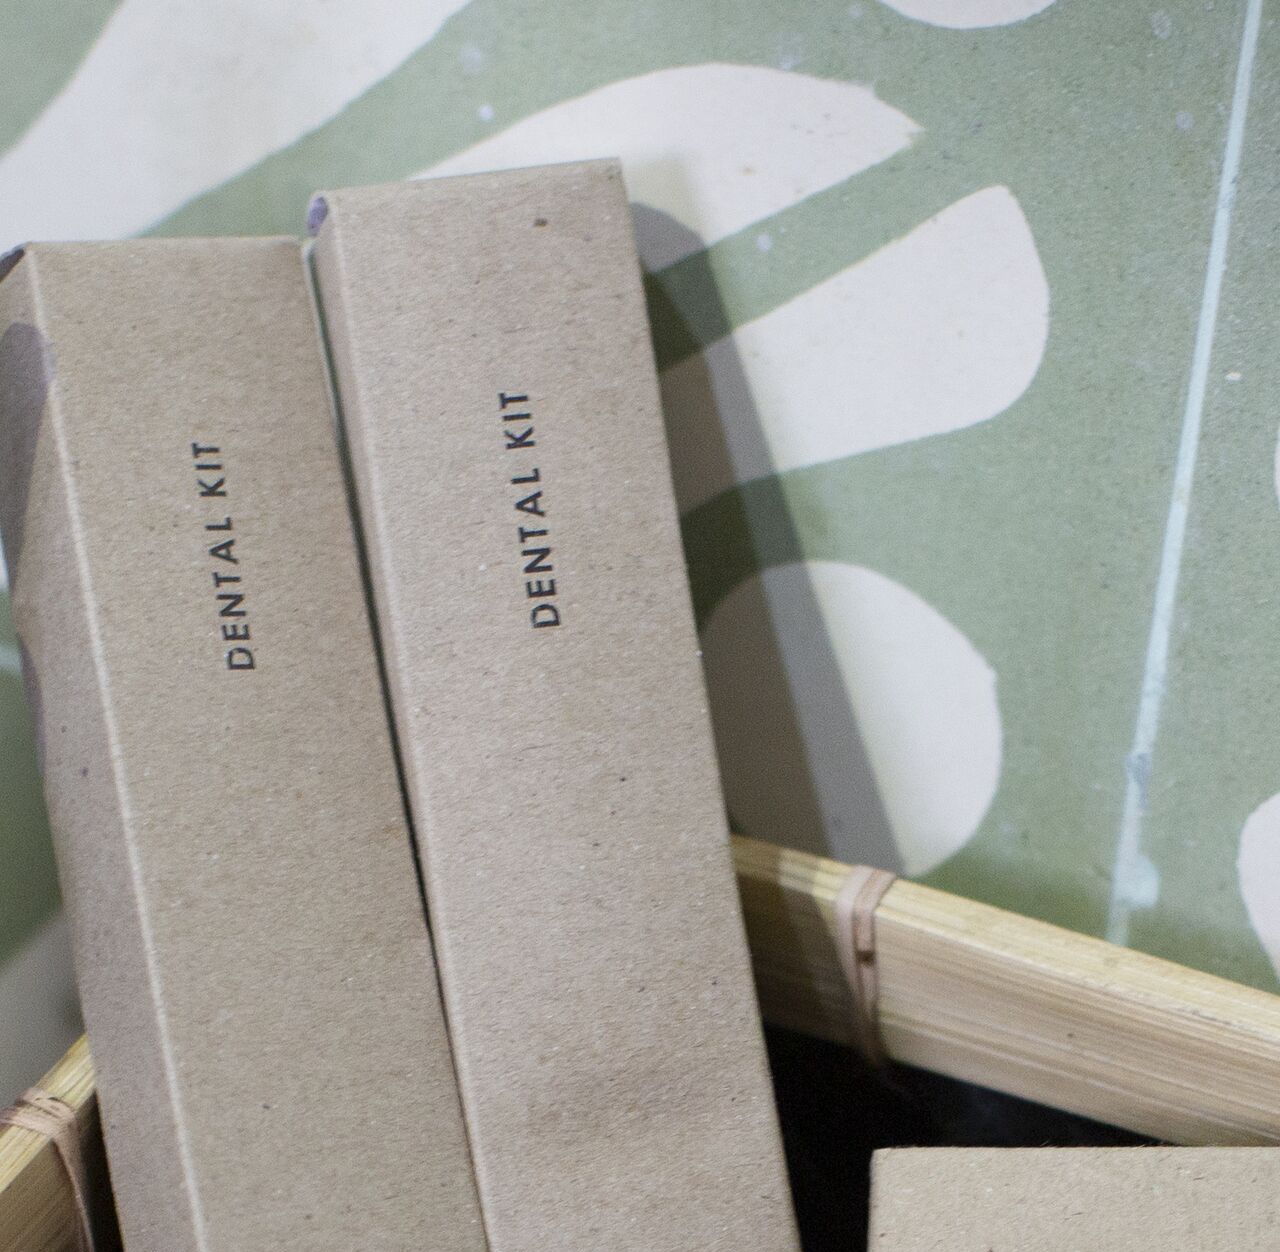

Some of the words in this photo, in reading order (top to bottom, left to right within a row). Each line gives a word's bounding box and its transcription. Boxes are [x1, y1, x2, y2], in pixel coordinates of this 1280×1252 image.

[192, 441, 228, 498] KIT
[498, 391, 536, 450] KIT
[205, 516, 256, 671] DENTAL
[510, 467, 562, 629] DENTAL
